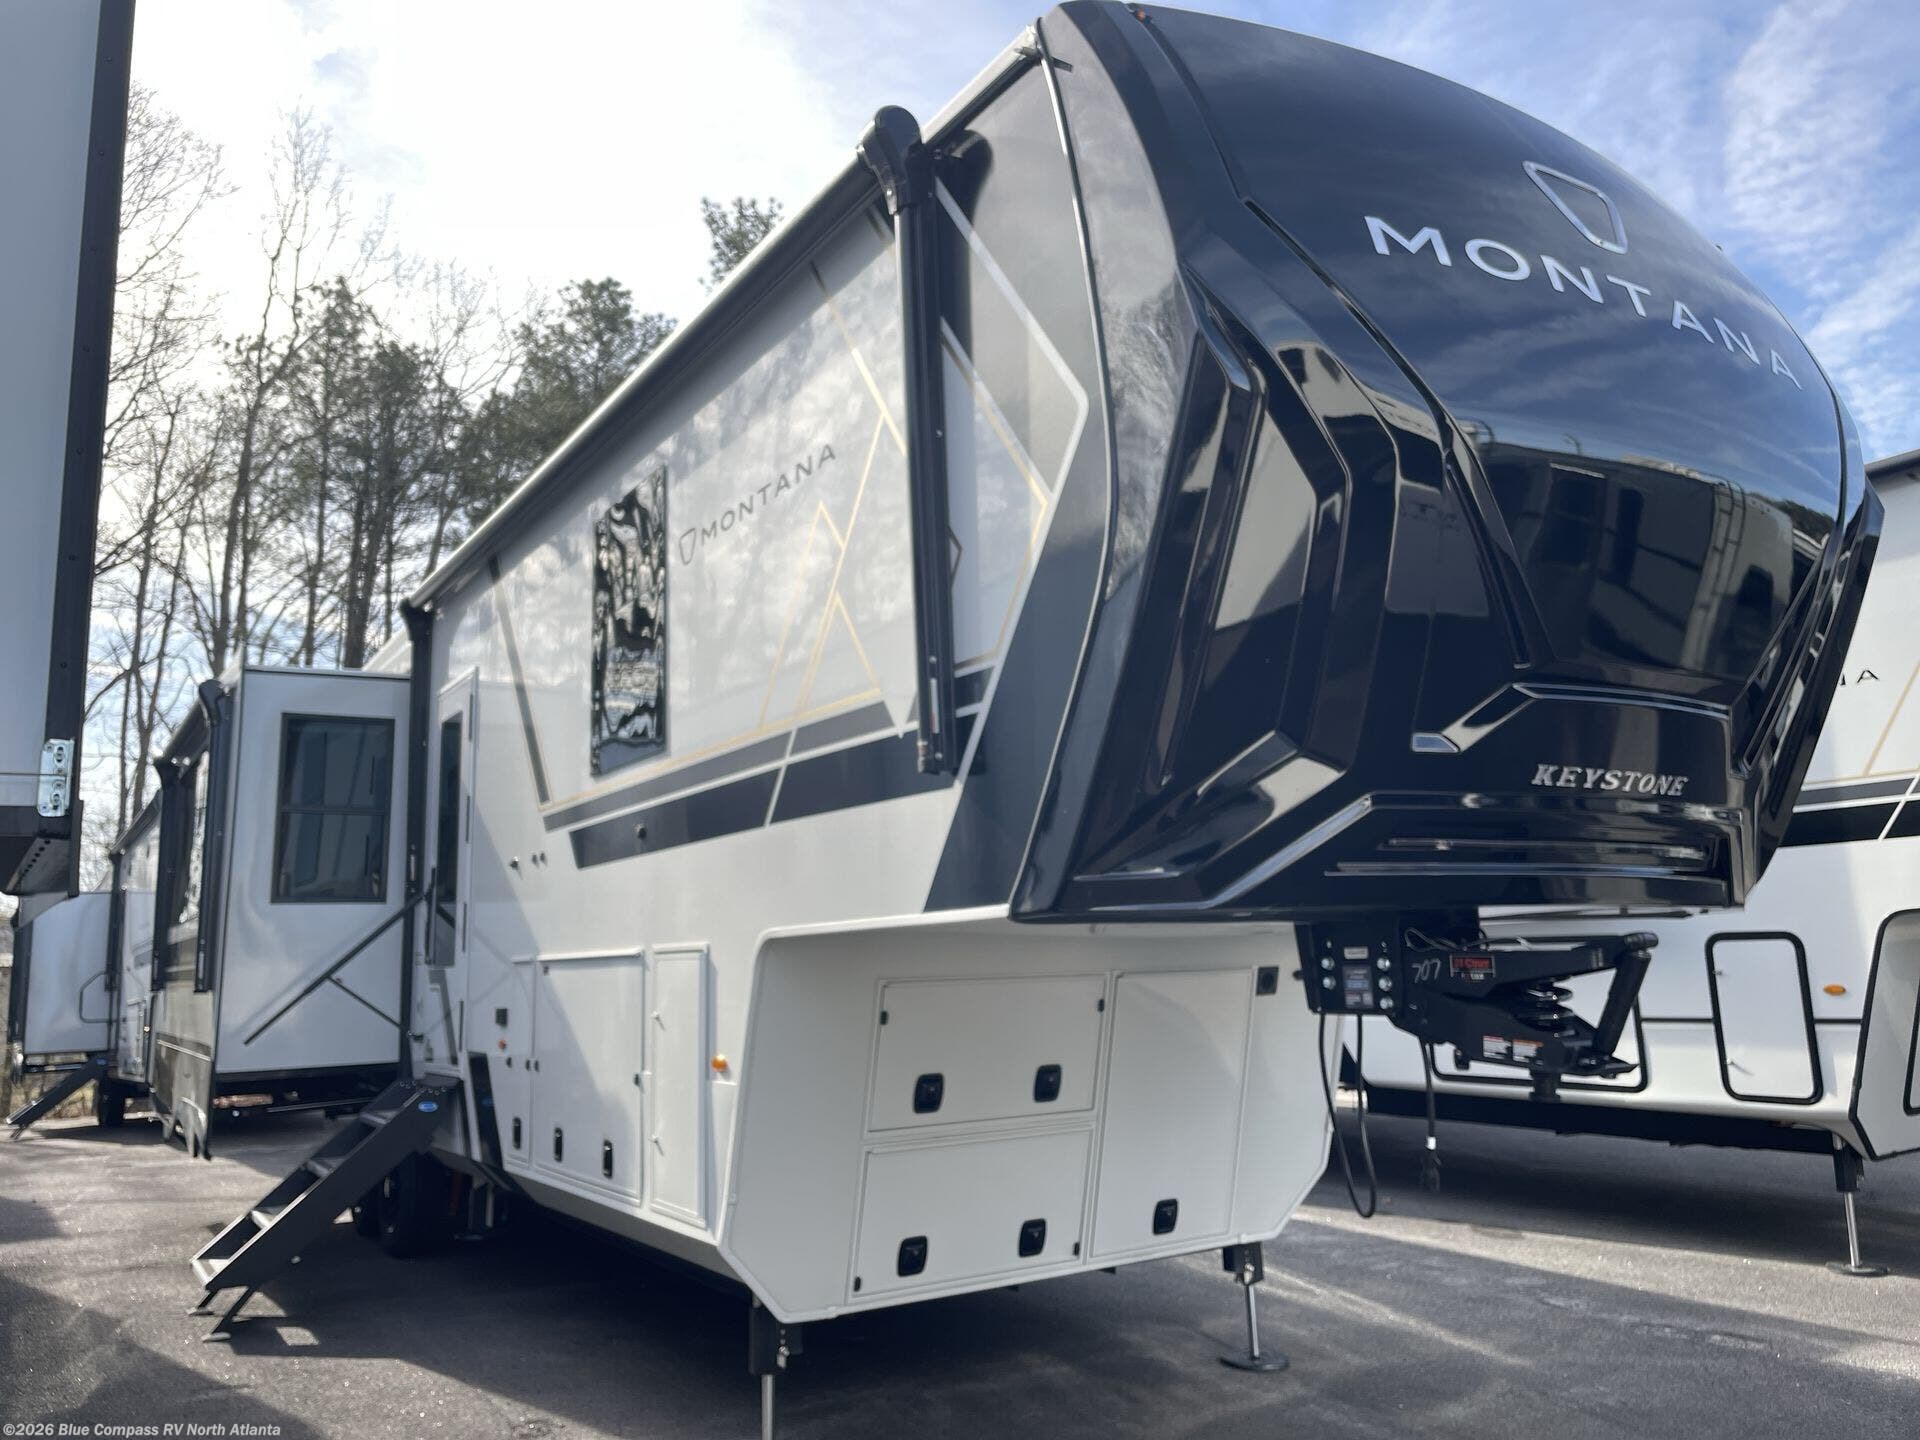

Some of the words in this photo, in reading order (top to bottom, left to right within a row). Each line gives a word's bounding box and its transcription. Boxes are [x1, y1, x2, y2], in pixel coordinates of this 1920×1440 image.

[1364, 215, 1803, 391] MONTANA
[700, 443, 837, 546] MONTANA
[1531, 763, 1690, 797] KEYSTONE
[1411, 958, 1442, 984] 707
